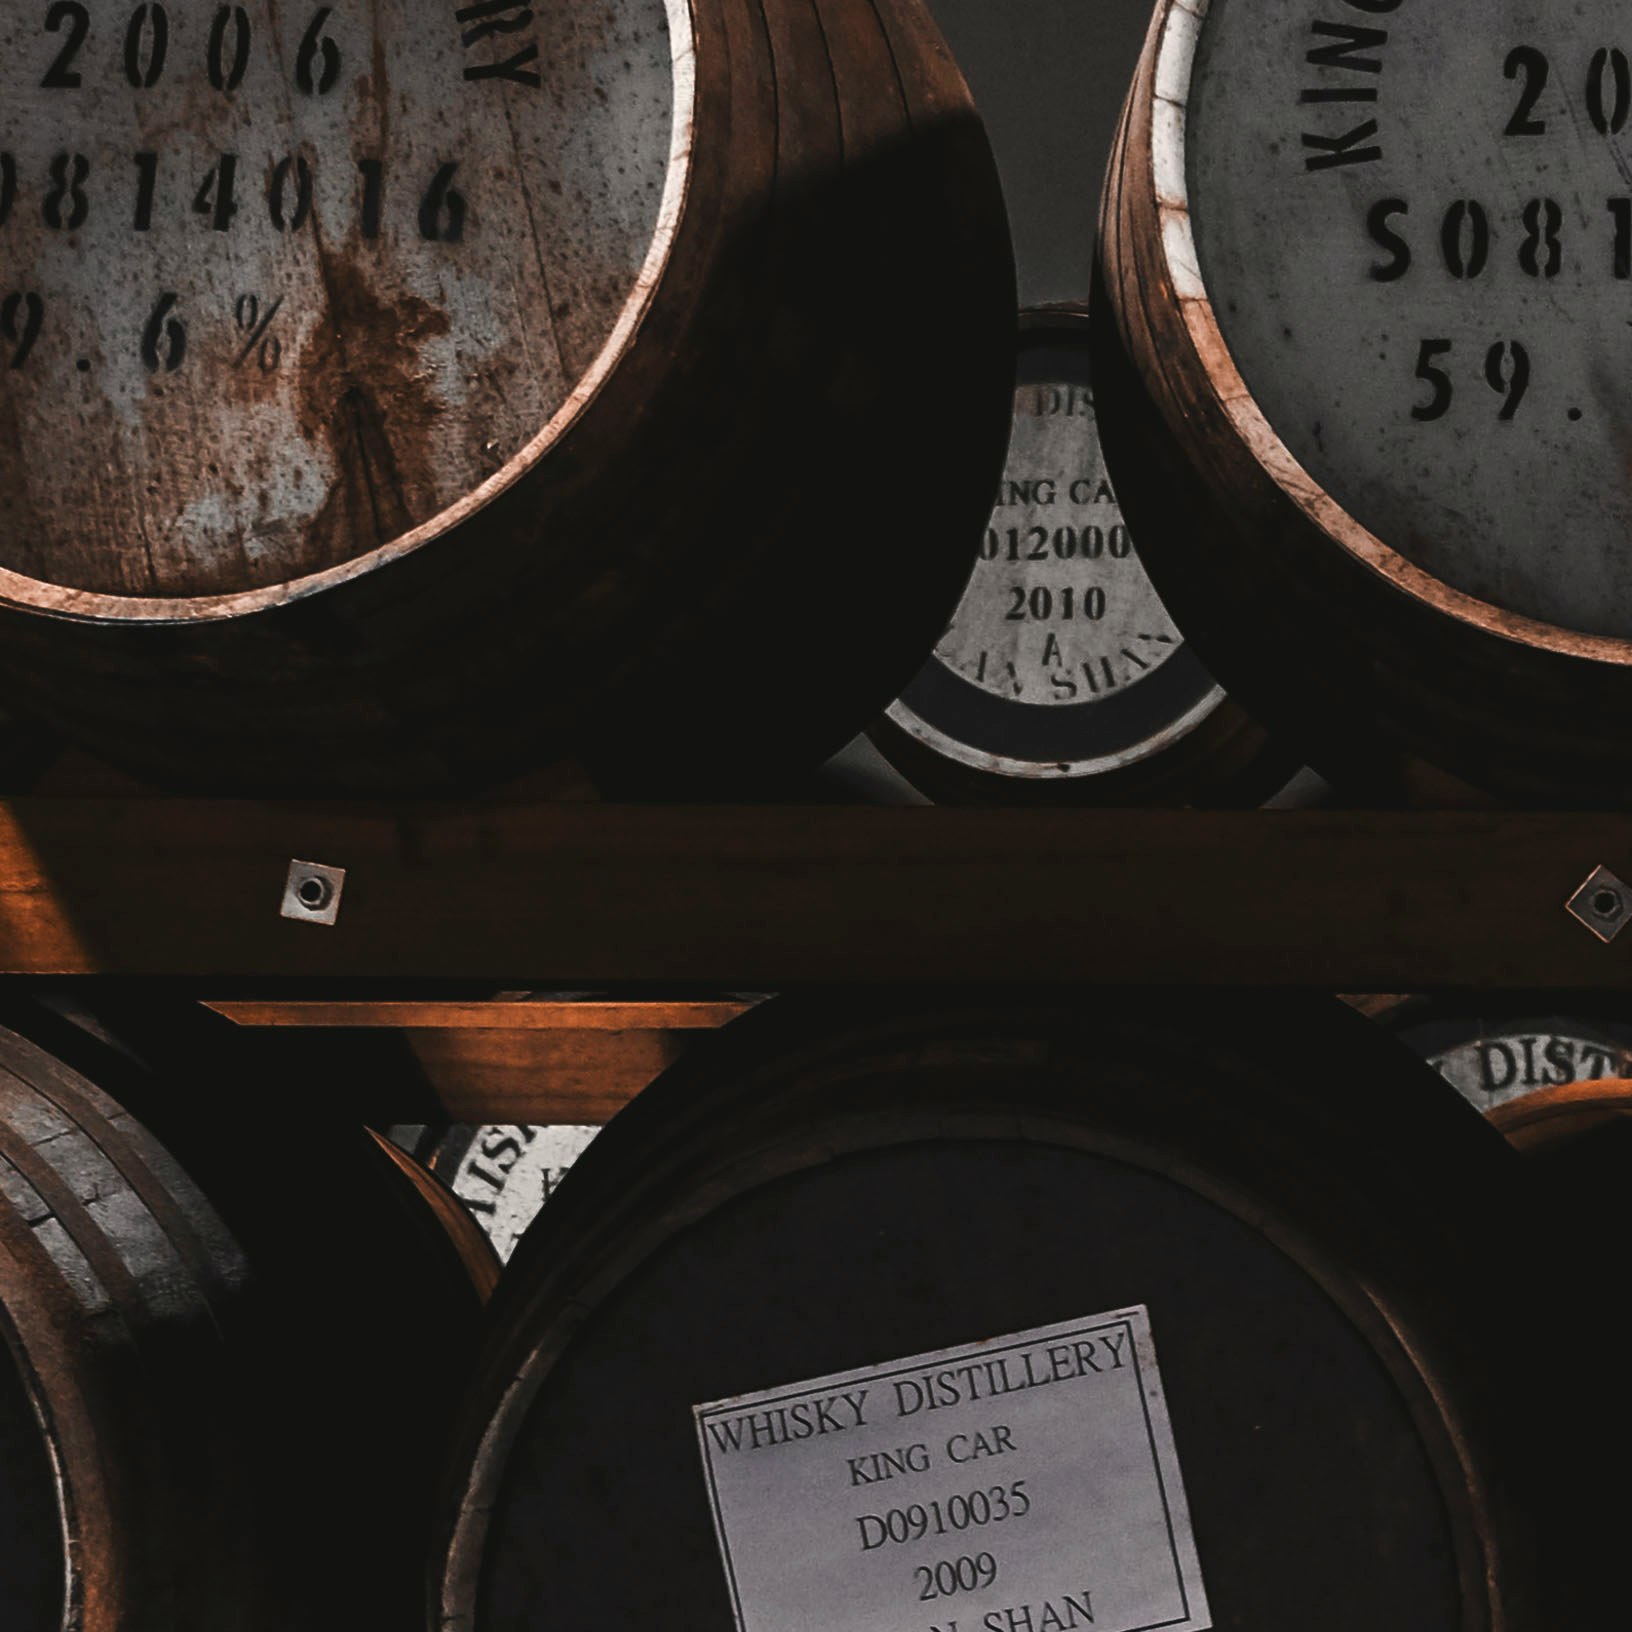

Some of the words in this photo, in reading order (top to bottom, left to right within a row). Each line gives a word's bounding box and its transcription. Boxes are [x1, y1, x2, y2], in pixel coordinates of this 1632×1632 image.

[40, 1, 341, 95] 2006
[1005, 587, 1107, 620] 2010
[708, 1390, 870, 1455] WHISKY
[893, 1333, 1127, 1418] DISTILLERY
[847, 1443, 932, 1486] KING
[946, 1424, 1017, 1464] CAR
[856, 1480, 1031, 1550] D0910035
[914, 1552, 998, 1601] 2009
